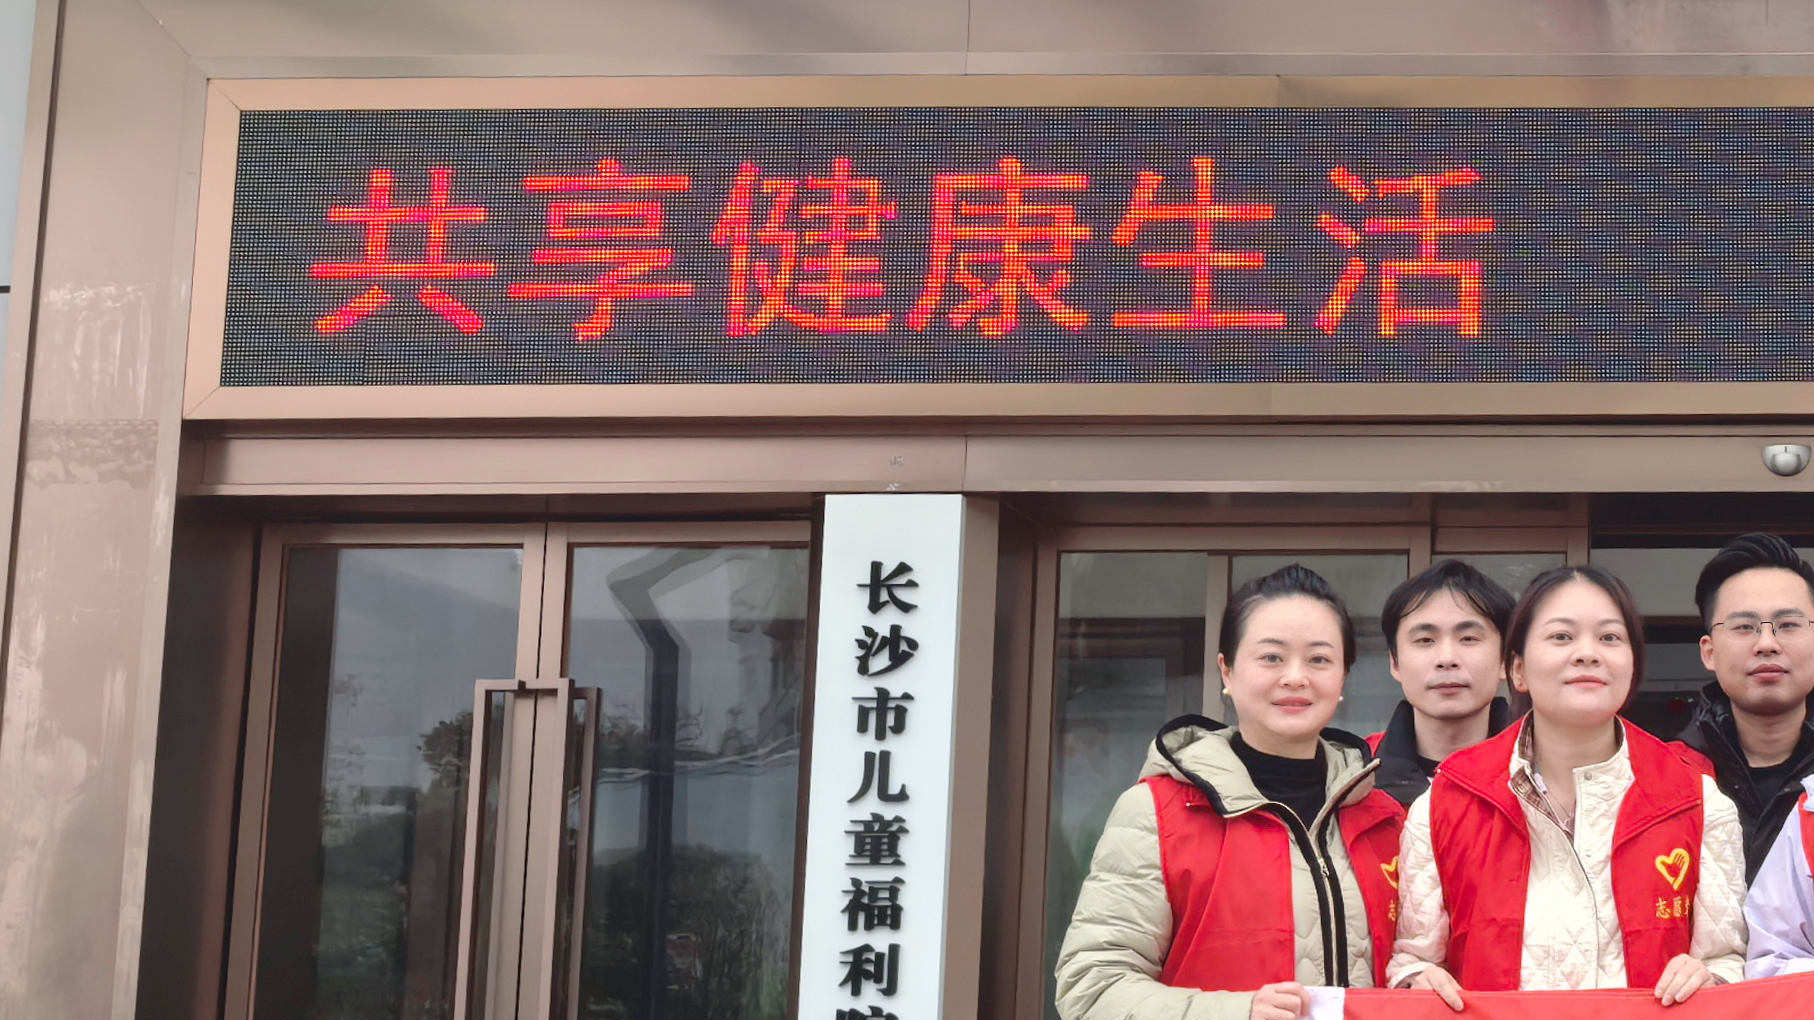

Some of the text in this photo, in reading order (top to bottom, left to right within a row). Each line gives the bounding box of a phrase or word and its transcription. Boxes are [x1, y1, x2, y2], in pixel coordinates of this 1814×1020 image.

[309, 157, 1495, 340] 共享健康生活
